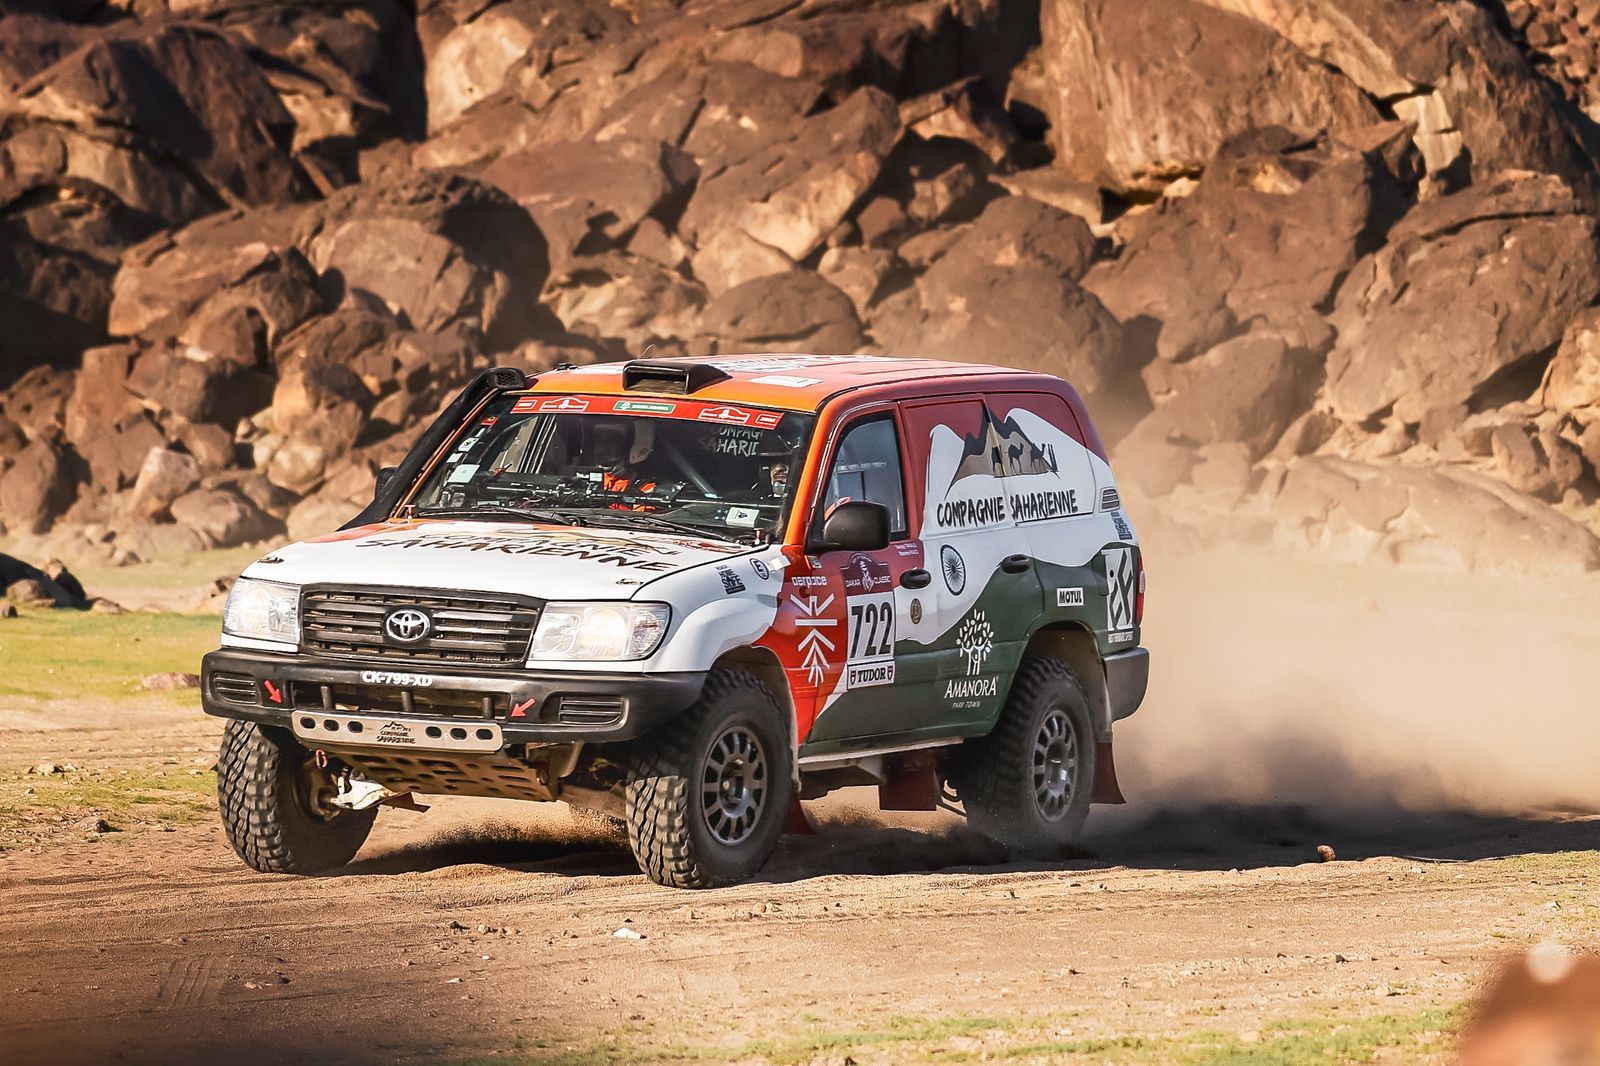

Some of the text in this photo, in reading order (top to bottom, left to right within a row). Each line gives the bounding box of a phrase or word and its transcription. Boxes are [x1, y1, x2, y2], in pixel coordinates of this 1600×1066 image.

[937, 497, 1006, 528] COMPAGNIE
[1010, 489, 1079, 522] SAHARIENNE
[355, 540, 680, 572] SAHARIENNE
[1058, 590, 1083, 604] MOTUL
[851, 601, 893, 659] 722
[361, 670, 433, 687] CK-799-XD
[857, 667, 887, 683] TUDOR
[943, 676, 997, 699] AMANORA
